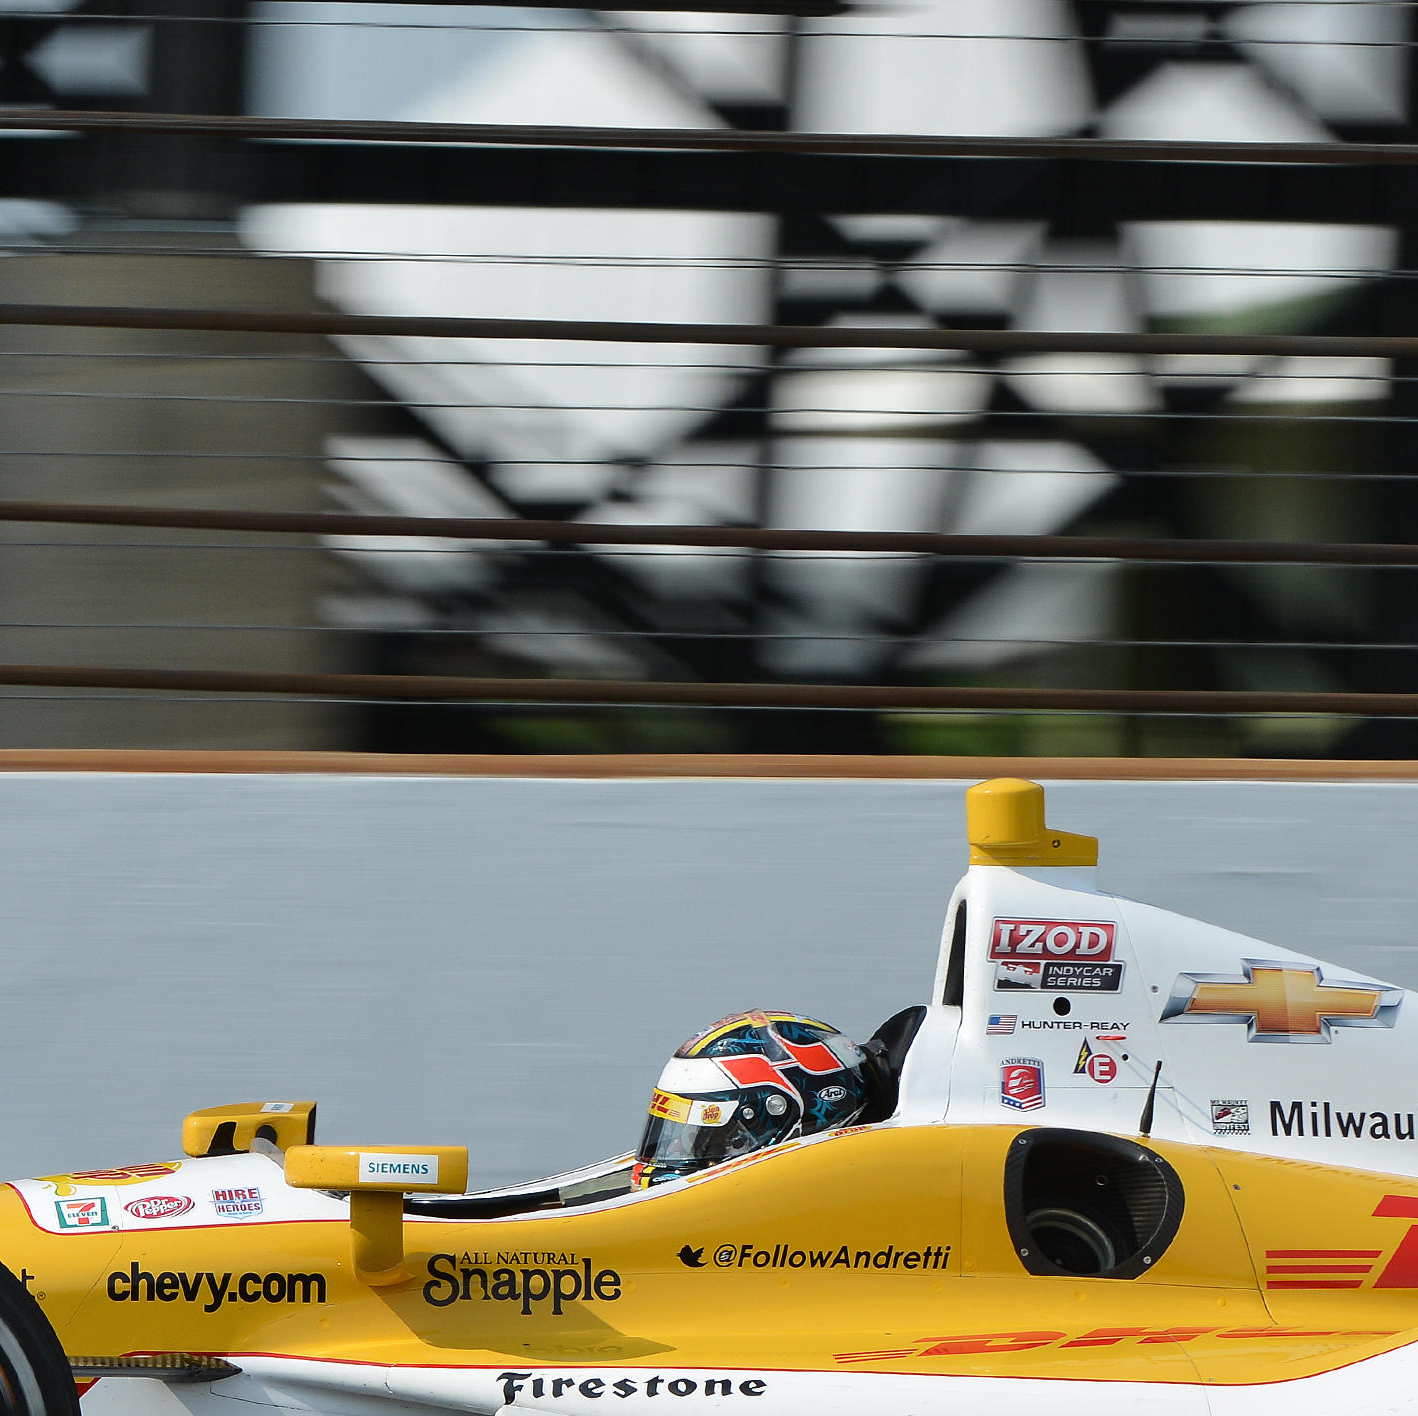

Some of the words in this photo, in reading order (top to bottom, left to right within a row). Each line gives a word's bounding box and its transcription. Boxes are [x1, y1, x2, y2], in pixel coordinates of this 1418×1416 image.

[995, 924, 1108, 955] IZOD
[1049, 966, 1114, 976] INDYCAR
[1047, 977, 1101, 987] SERIES
[1021, 1021, 1130, 1031] HUNTER-REAY
[1001, 1059, 1040, 1067] ANDRETTI
[1093, 1058, 1111, 1080] E
[368, 1162, 429, 1175] SIEMENS
[214, 1188, 259, 1201] HIRE
[137, 1199, 182, 1218] Pepper
[217, 1202, 261, 1213] HEROES
[460, 1251, 492, 1265] ALL
[496, 1251, 580, 1265] NATURAL
[713, 1244, 952, 1270] @FollowAndretti
[107, 1261, 327, 1313] chevy.com
[423, 1254, 622, 1316] Snapple
[496, 1372, 767, 1405] Firestone
